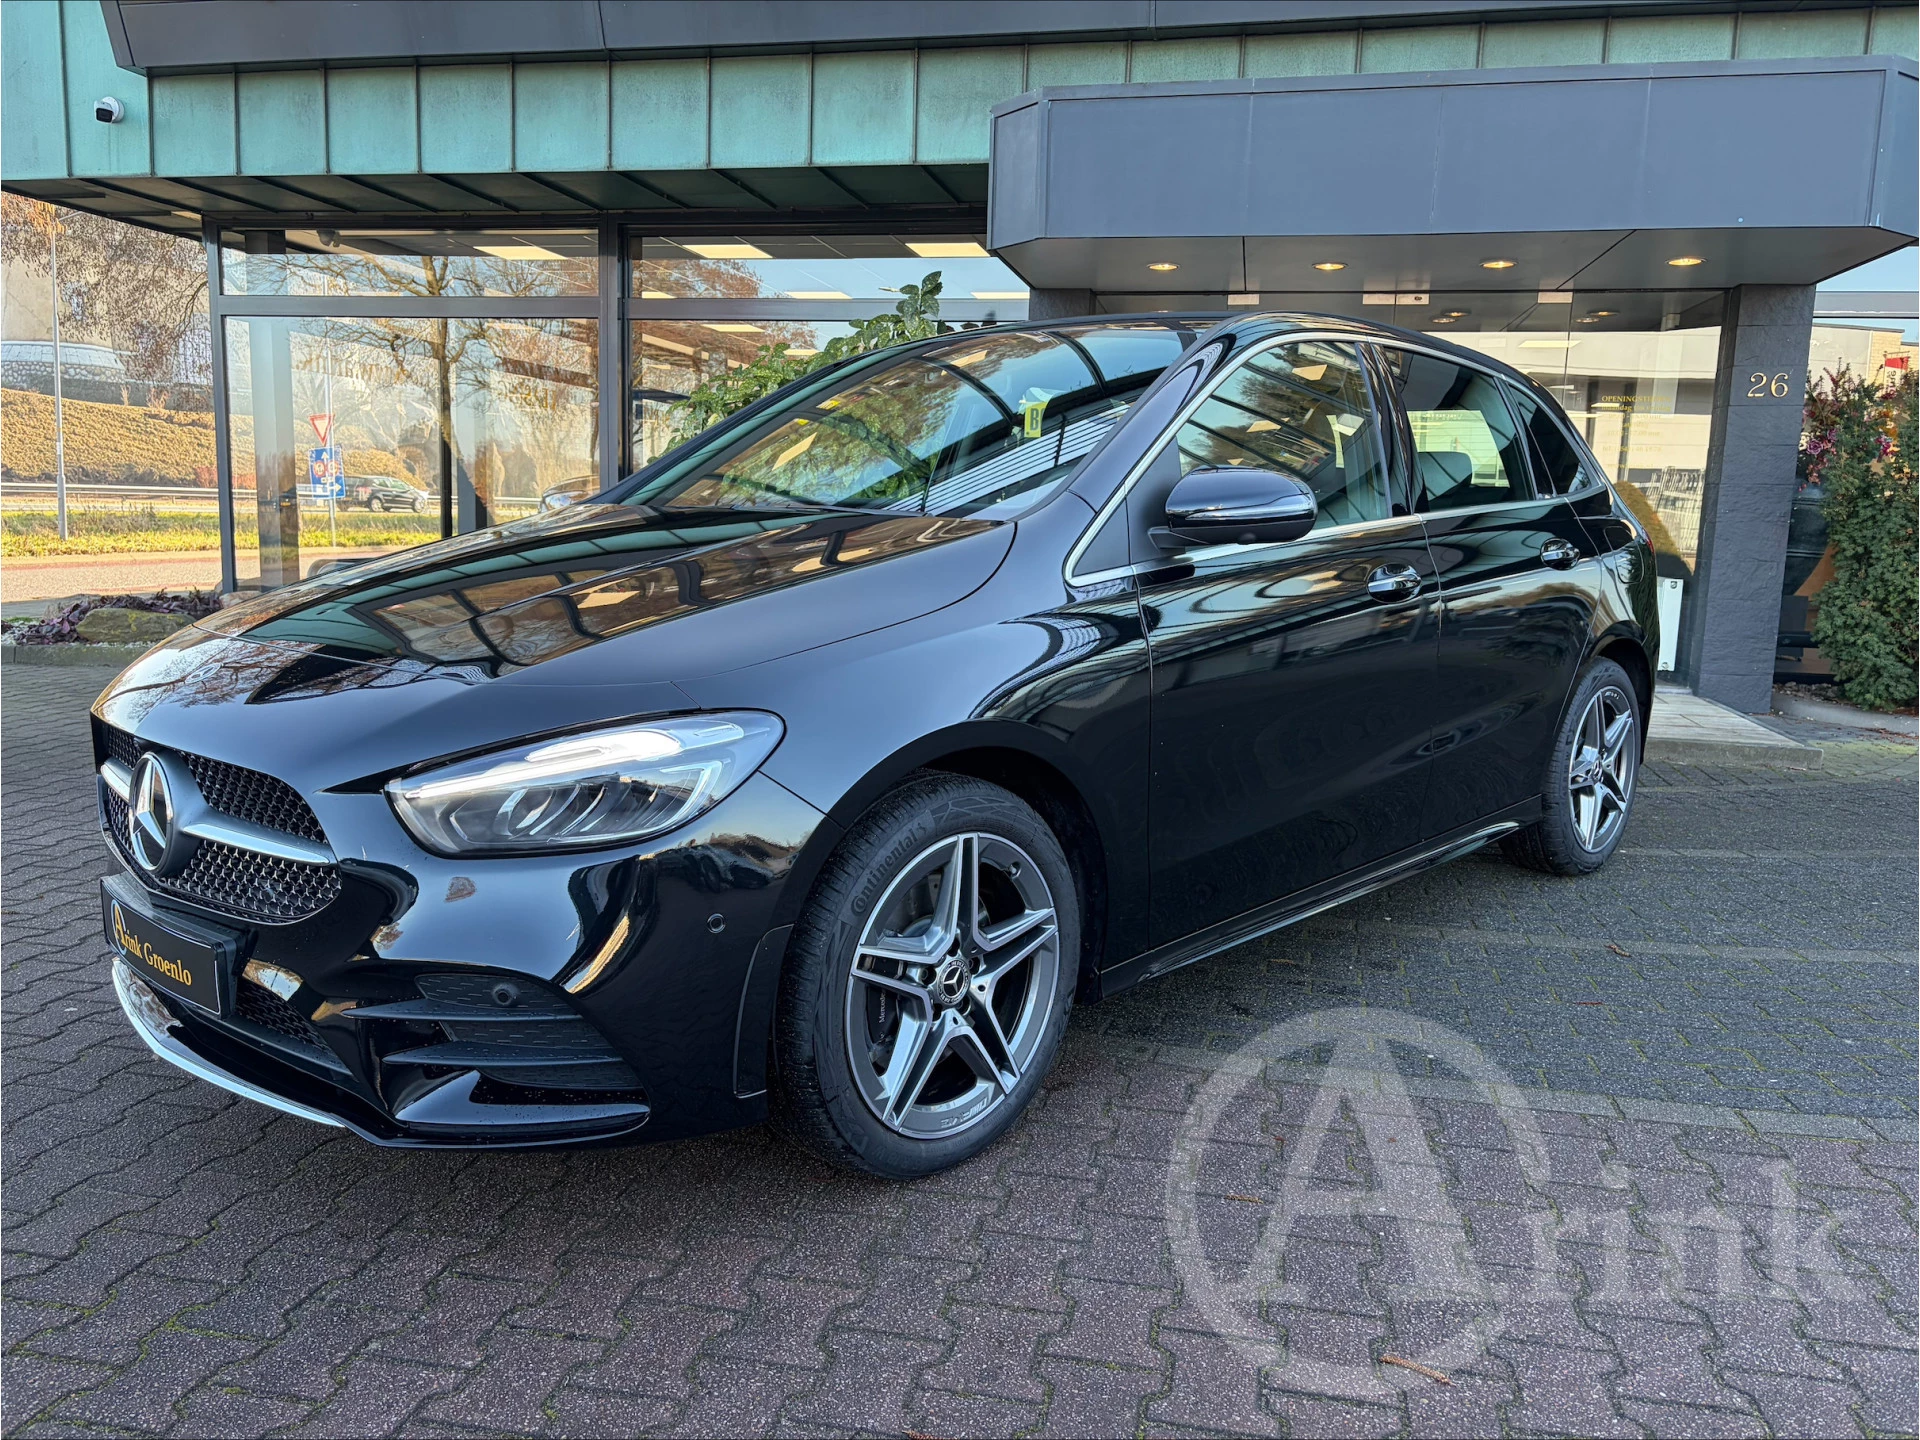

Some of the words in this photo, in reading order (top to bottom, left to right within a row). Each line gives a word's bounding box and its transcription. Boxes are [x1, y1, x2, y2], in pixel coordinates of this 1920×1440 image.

[1747, 372, 1789, 398] 26
[1030, 407, 1045, 431] B
[850, 828, 919, 916] Continental
[114, 904, 143, 959] Arink
[144, 942, 192, 986] Groenlo
